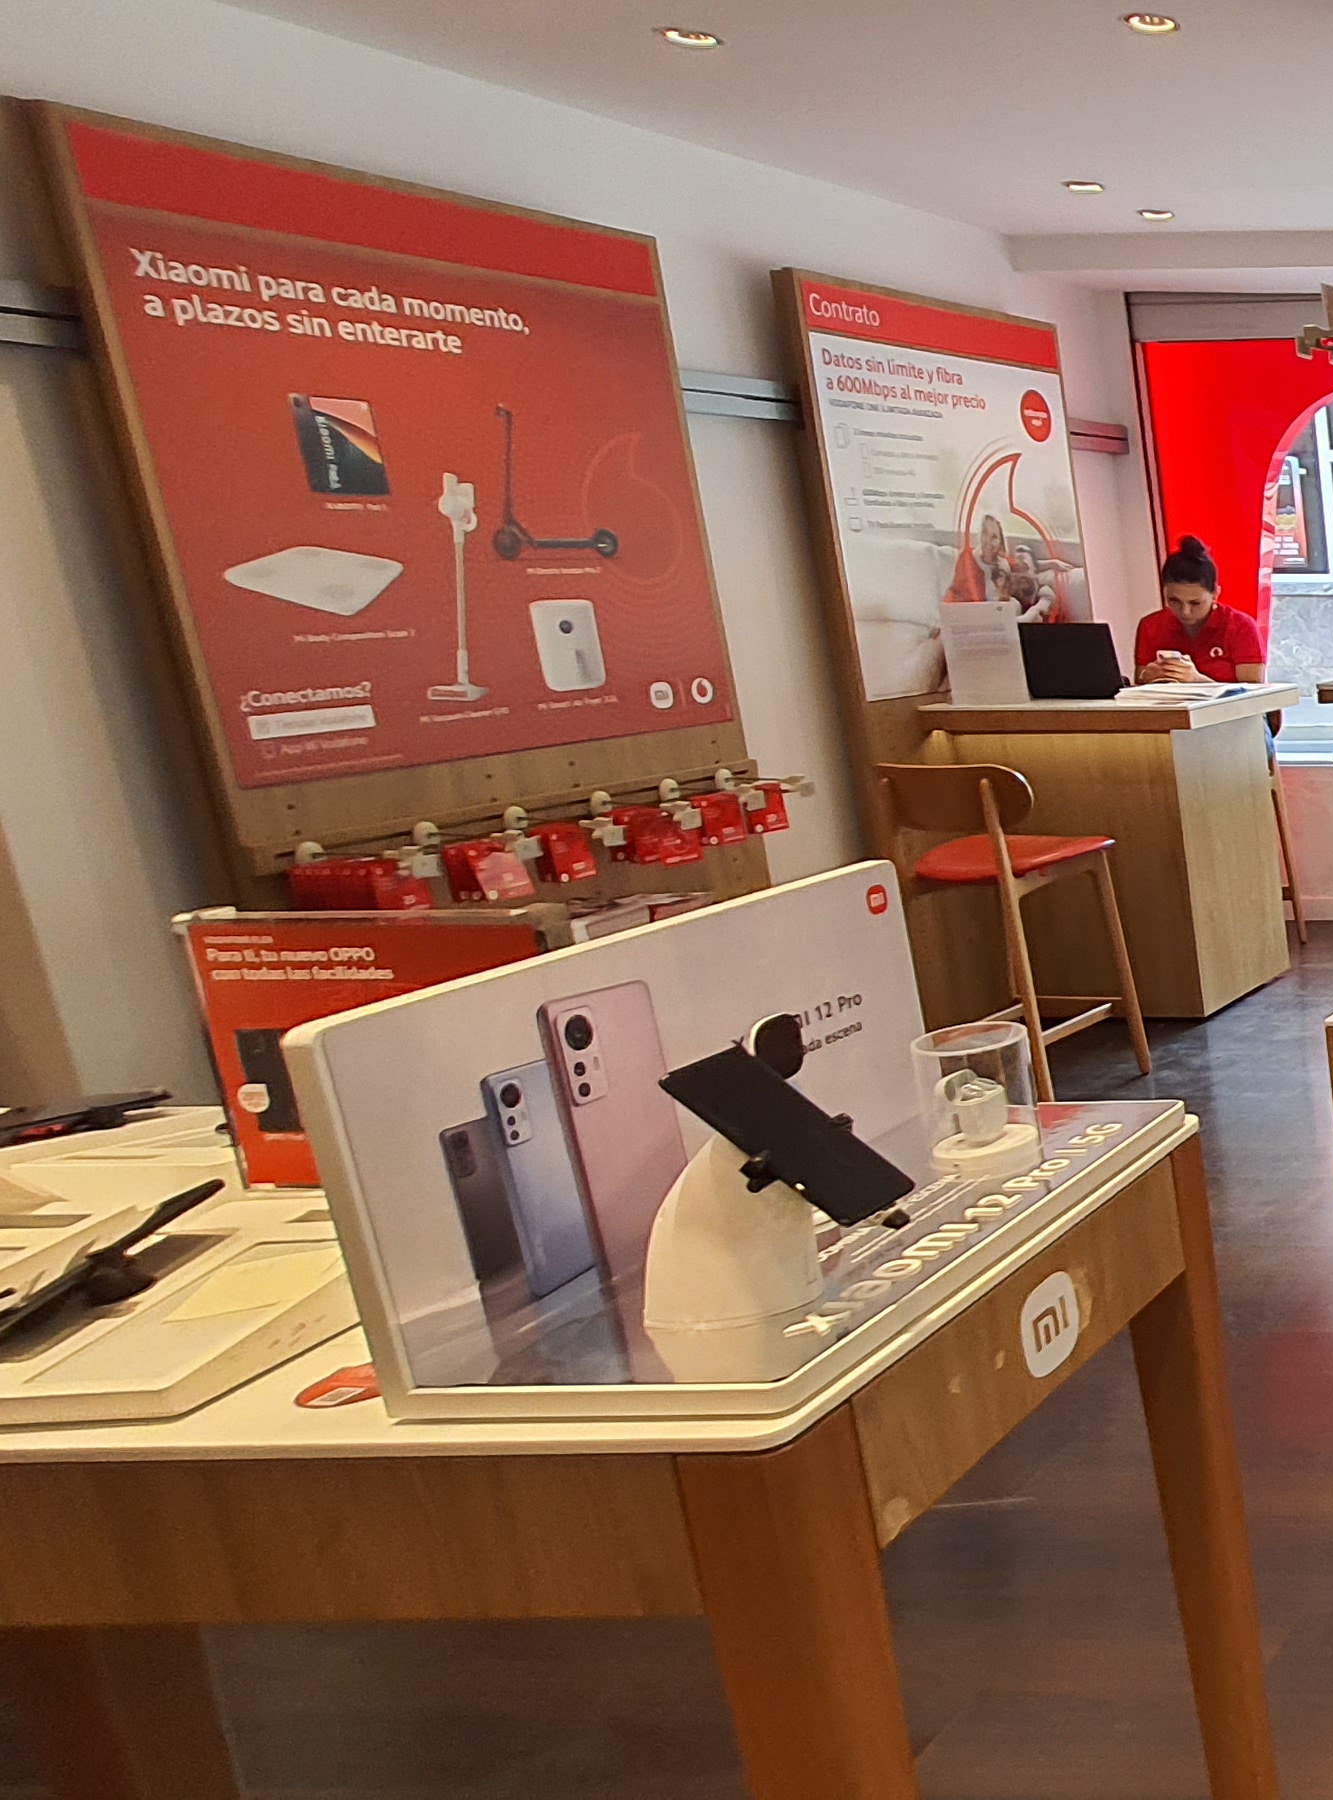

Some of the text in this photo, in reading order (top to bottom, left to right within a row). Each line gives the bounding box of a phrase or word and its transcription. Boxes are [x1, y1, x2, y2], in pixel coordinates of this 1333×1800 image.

[128, 246, 531, 336] Xiaomi para cada momento,
[143, 293, 464, 355] a plazos sin enterarte
[808, 293, 880, 328] Contrato
[821, 347, 964, 387] Datos sin límite y fibra
[826, 375, 986, 411] a 600Mbps al mejor precio
[239, 681, 372, 712] ¿Conectamos?
[329, 947, 375, 961] OPPO
[814, 1001, 833, 1021] 12
[838, 994, 863, 1013] Pro
[825, 1020, 863, 1045] escena
[963, 1193, 1025, 1223] 12
[1001, 1158, 1072, 1192] Pro
[1067, 1122, 1124, 1148] 5G
